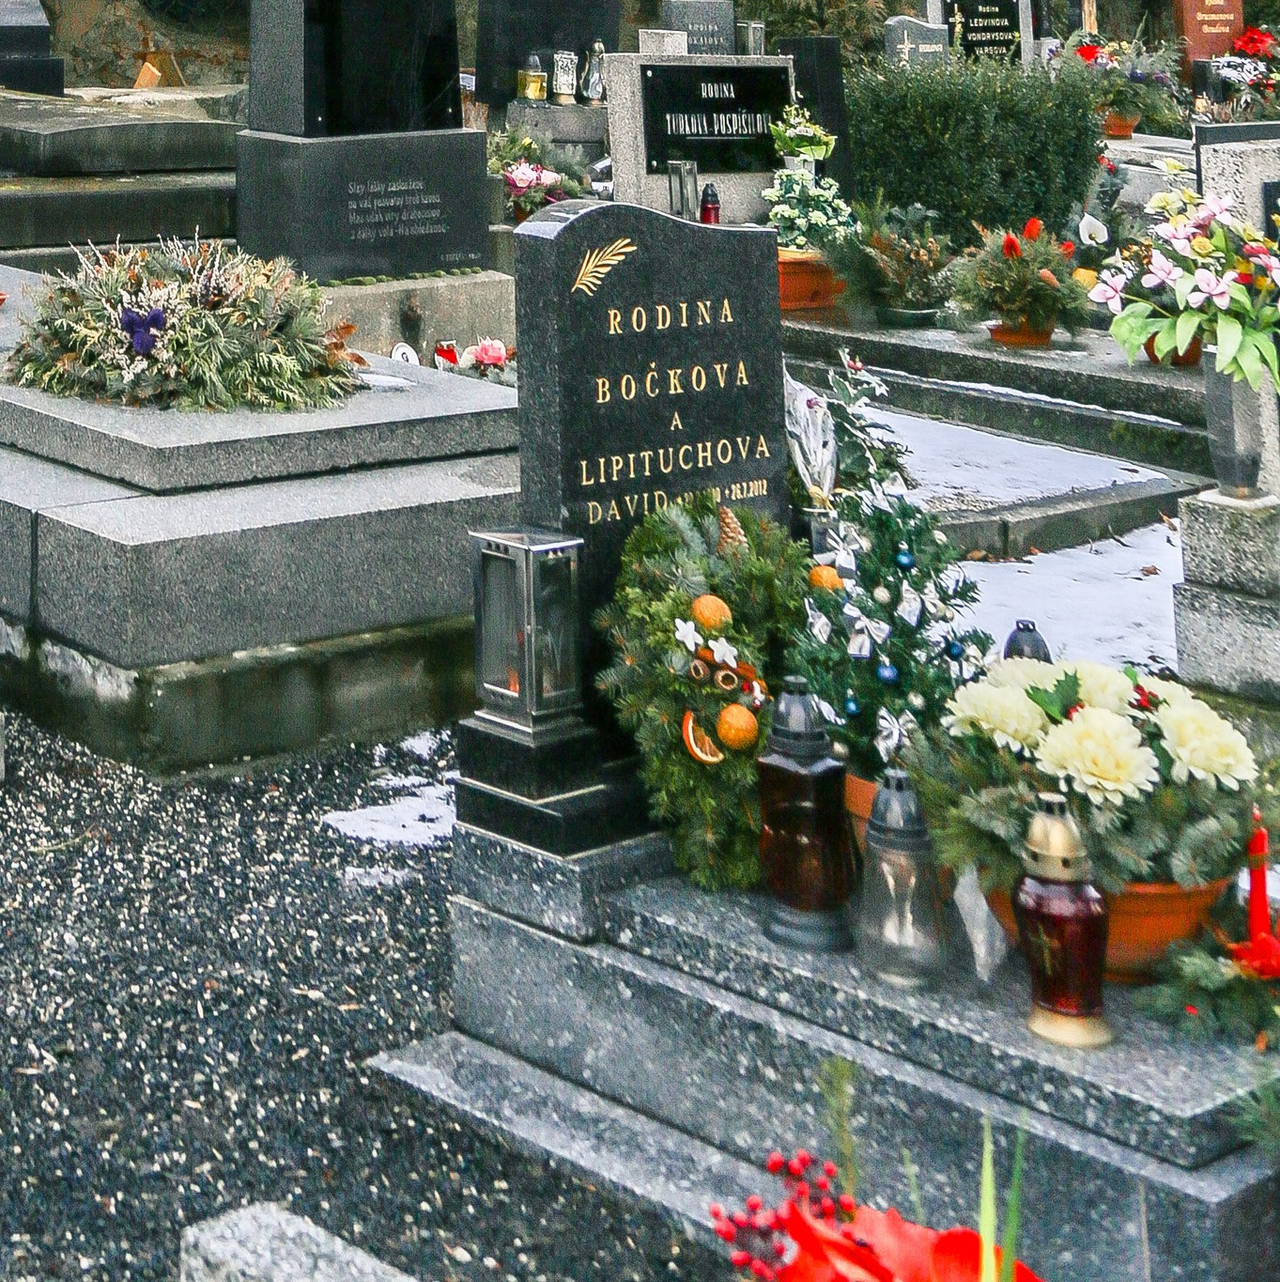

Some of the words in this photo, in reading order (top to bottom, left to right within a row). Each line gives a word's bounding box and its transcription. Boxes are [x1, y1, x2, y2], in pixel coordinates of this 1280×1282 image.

[969, 18, 1010, 27] LEDVINOVA
[978, 5, 999, 14] Rodina
[701, 82, 736, 99] RODINA
[608, 297, 734, 335] RODINA
[596, 360, 750, 403] BOČKOVA
[670, 410, 683, 431] A
[580, 434, 771, 486] LIPITUCHOVA
[587, 490, 668, 525] DAVID
